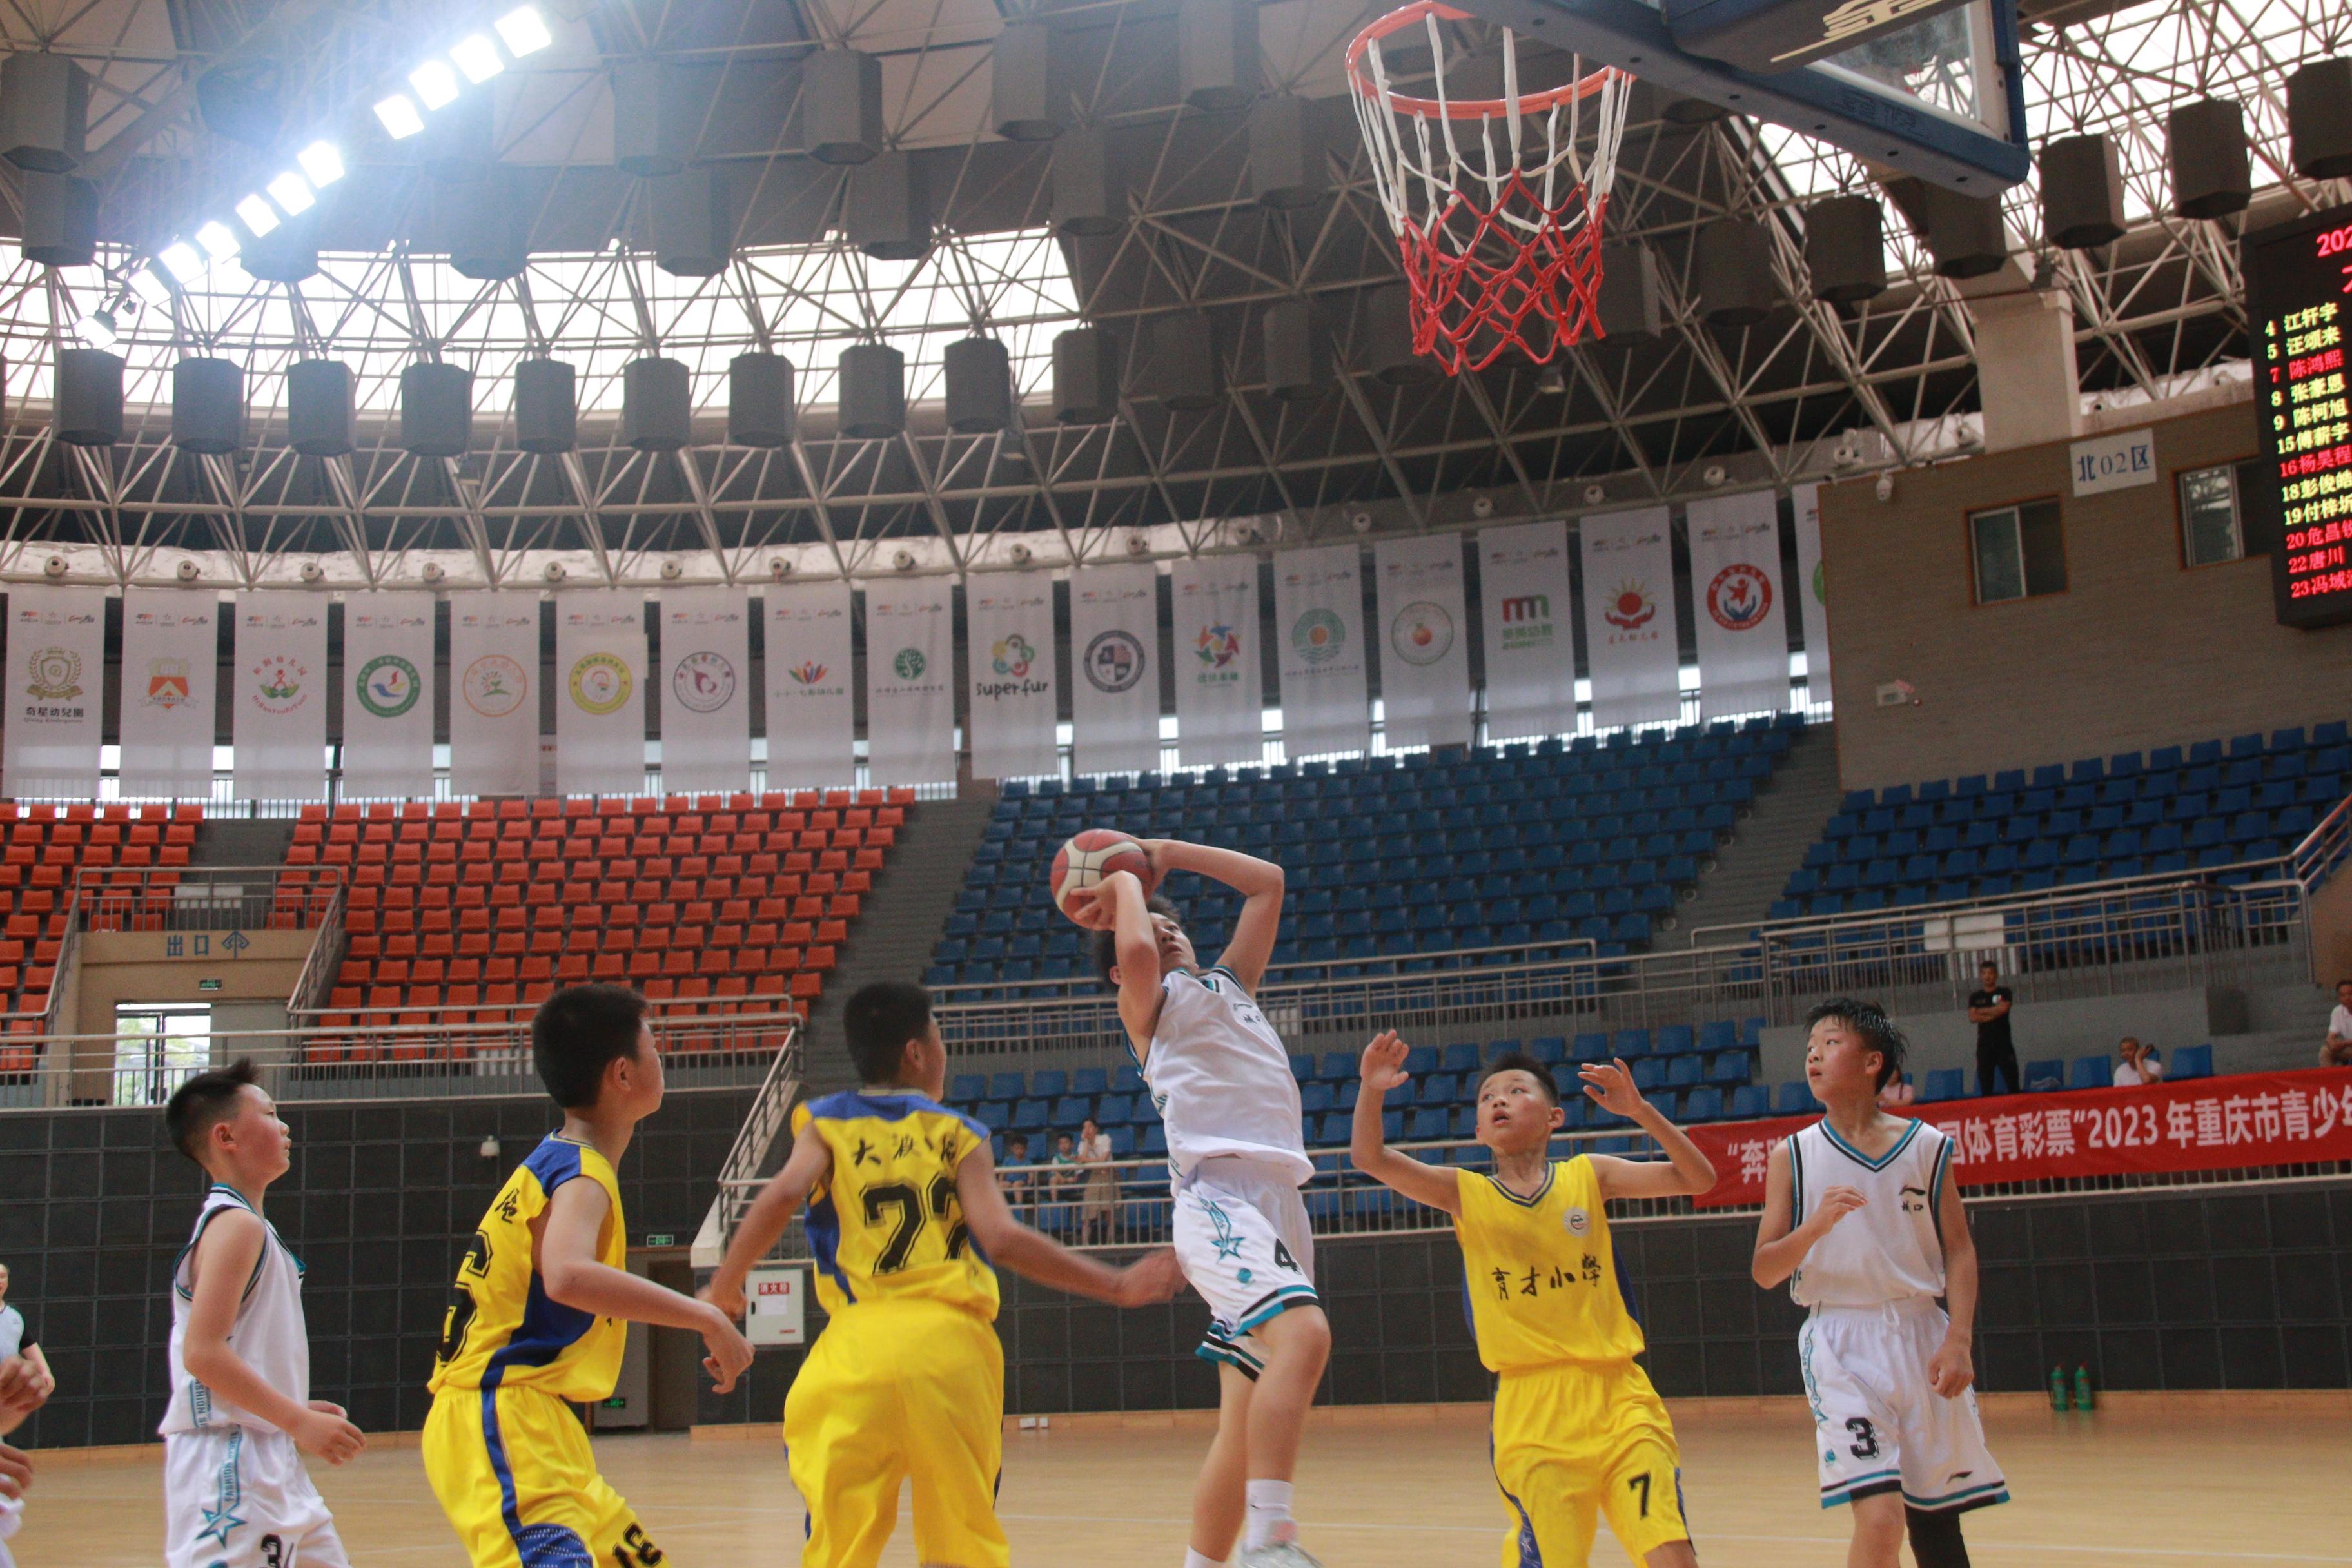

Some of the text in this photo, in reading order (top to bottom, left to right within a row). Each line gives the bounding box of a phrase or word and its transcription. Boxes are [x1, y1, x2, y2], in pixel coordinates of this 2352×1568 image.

[2264, 320, 2277, 337] 4
[2267, 343, 2278, 360] 5
[2269, 366, 2280, 383] 7
[2271, 390, 2284, 407] 8
[2273, 415, 2286, 431] 9
[2077, 444, 2149, 482] 北02区
[167, 935, 210, 957] 出口
[1274, 1237, 1304, 1276] 4
[1845, 1417, 1879, 1460] 3
[1629, 1470, 1651, 1520] 7
